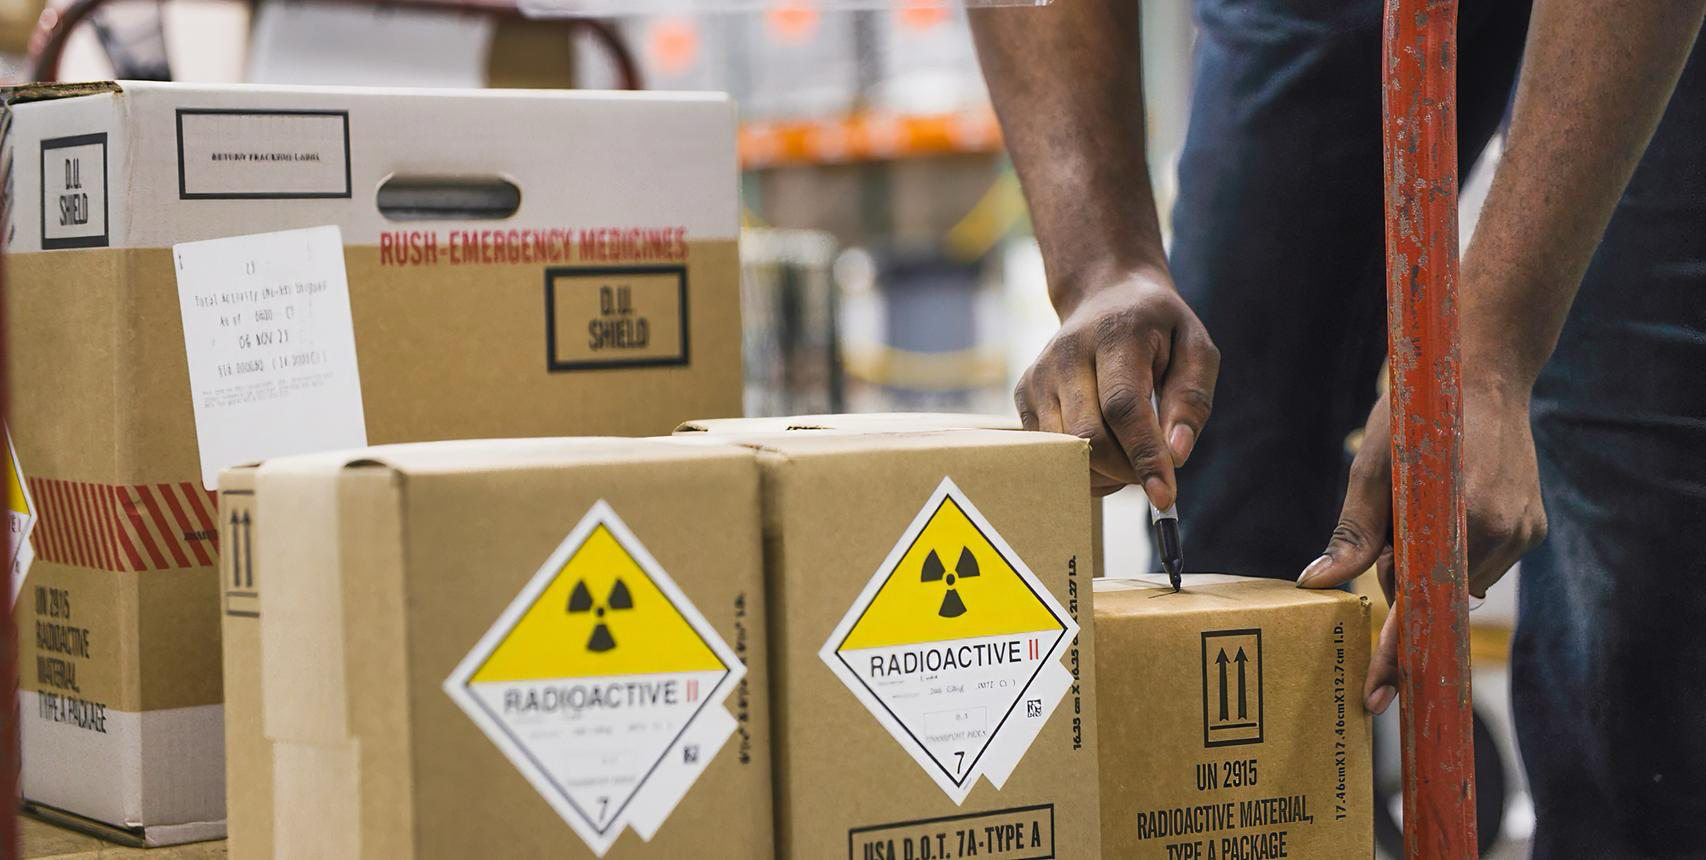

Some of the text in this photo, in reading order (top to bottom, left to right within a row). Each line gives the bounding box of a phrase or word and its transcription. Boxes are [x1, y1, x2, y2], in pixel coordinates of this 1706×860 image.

[65, 158, 82, 189] D.U.
[59, 193, 88, 226] SHIELD
[380, 225, 688, 265] RUSH-EMERGENCY MEDICINES
[600, 286, 633, 315] D.U.
[588, 318, 650, 351] SHIELD
[871, 638, 1039, 678] RADIOACTIVE II
[503, 679, 699, 713] RADIOACTIVE II
[954, 751, 965, 774] 7
[1196, 759, 1257, 790] UN 2915
[596, 796, 609, 822] 7
[1137, 794, 1313, 840] RADIOACTIVE MATERIAL,
[864, 840, 895, 860] USA
[957, 823, 1024, 857] 7A-TYPE
[1031, 821, 1041, 848] A
[1166, 831, 1288, 860] TYPE A PACKAGE
